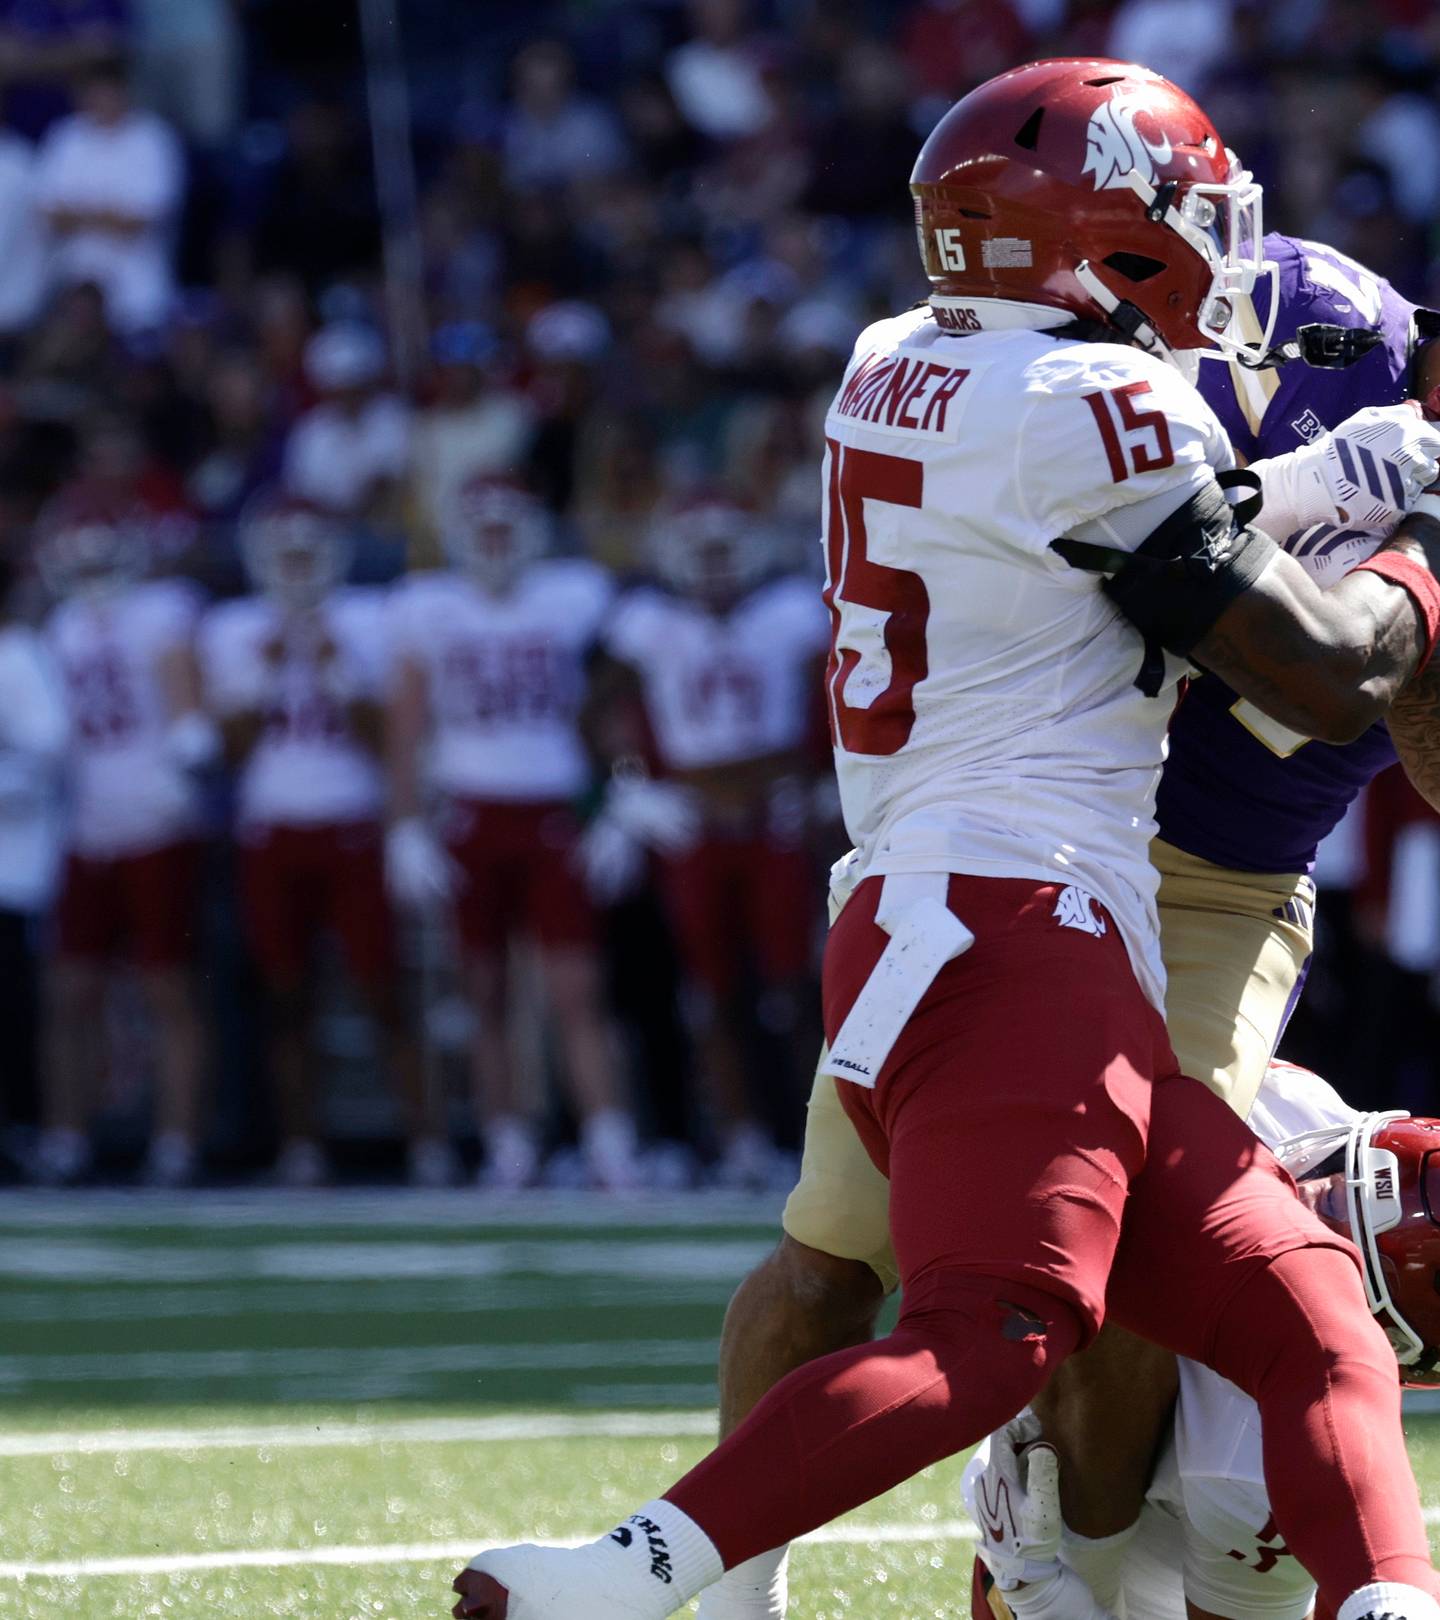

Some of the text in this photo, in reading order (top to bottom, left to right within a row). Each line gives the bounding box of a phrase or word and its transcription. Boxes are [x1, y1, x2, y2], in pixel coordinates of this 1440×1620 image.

[934, 228, 966, 271] 15
[1081, 380, 1175, 484] 15
[822, 436, 930, 756] 15
[1372, 1166, 1393, 1200] WSU
